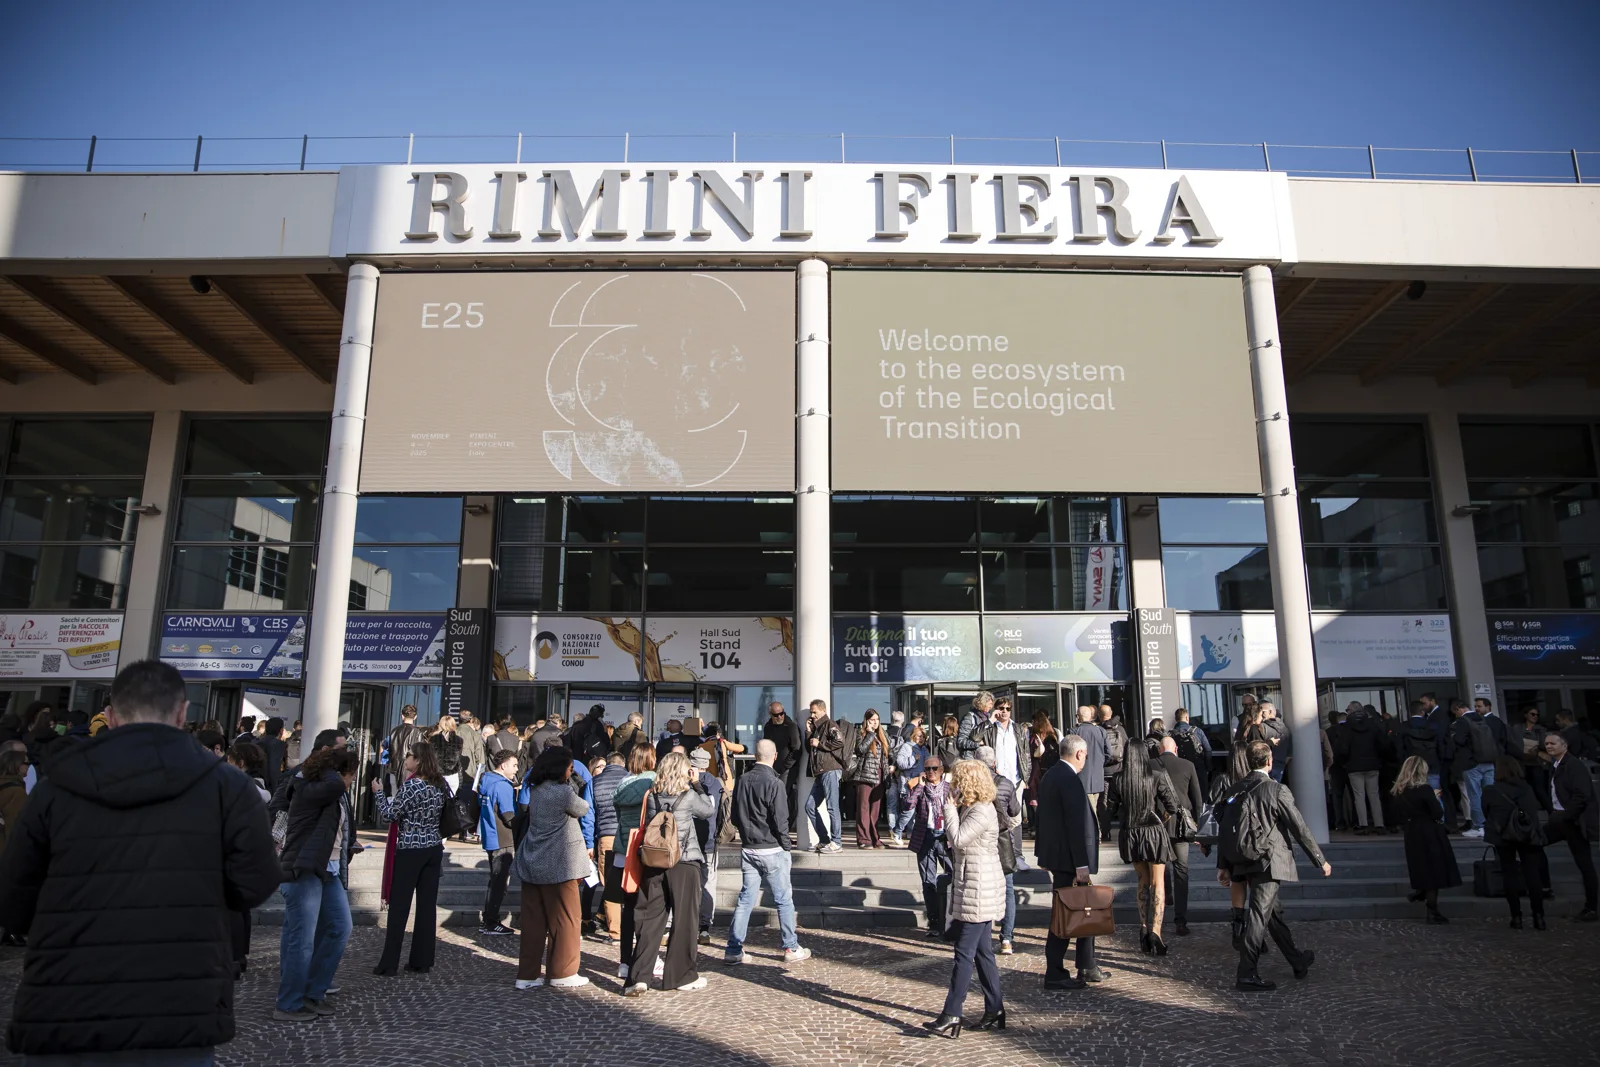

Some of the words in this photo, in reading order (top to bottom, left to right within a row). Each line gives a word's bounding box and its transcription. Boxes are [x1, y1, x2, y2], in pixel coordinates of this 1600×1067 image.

[402, 169, 813, 240] RIMINI
[871, 171, 1223, 242] FIERA
[421, 302, 484, 329] E25
[879, 328, 1009, 352] Welcome
[879, 359, 906, 380] to
[916, 356, 962, 380] the
[972, 361, 1125, 387] ecosystem
[879, 384, 906, 409] of
[916, 384, 961, 409] the
[973, 386, 1116, 417] Ecological
[879, 415, 1021, 440] Transition
[468, 450, 485, 458] Italy
[450, 609, 472, 621] Sud
[1140, 609, 1162, 621] Sud
[167, 616, 236, 628] CARNOVALI
[263, 618, 289, 629] CBS
[367, 621, 382, 630] per
[384, 620, 393, 629] la
[395, 620, 433, 630] raccolta,
[449, 623, 480, 636] South
[700, 629, 719, 637] Hall
[721, 629, 741, 637] Sud
[907, 626, 917, 641] il
[920, 628, 948, 641] tuo
[1003, 629, 1022, 637] RLG
[1142, 622, 1173, 636] South
[388, 632, 429, 641] trasporto
[562, 633, 602, 641] CONSORZIO
[1496, 634, 1531, 642] Efficienza
[1531, 634, 1570, 643] energetica
[363, 645, 379, 653] per
[380, 643, 422, 654] l'ecologia
[700, 638, 741, 650] Stand
[844, 643, 895, 657] futuro
[898, 643, 962, 657] insieme
[1004, 646, 1042, 654] ReDress
[1512, 643, 1544, 651] davvero,
[83, 659, 101, 667] STAND
[200, 661, 221, 669] A5-C5
[446, 641, 465, 678] Fiera
[699, 652, 742, 669] 104
[1004, 660, 1049, 670] Consorzio
[1051, 661, 1069, 669] RLG
[1144, 641, 1160, 678] Fiera
[844, 662, 855, 673] a
[859, 659, 889, 673] noi!
[1145, 681, 1164, 728] imini
